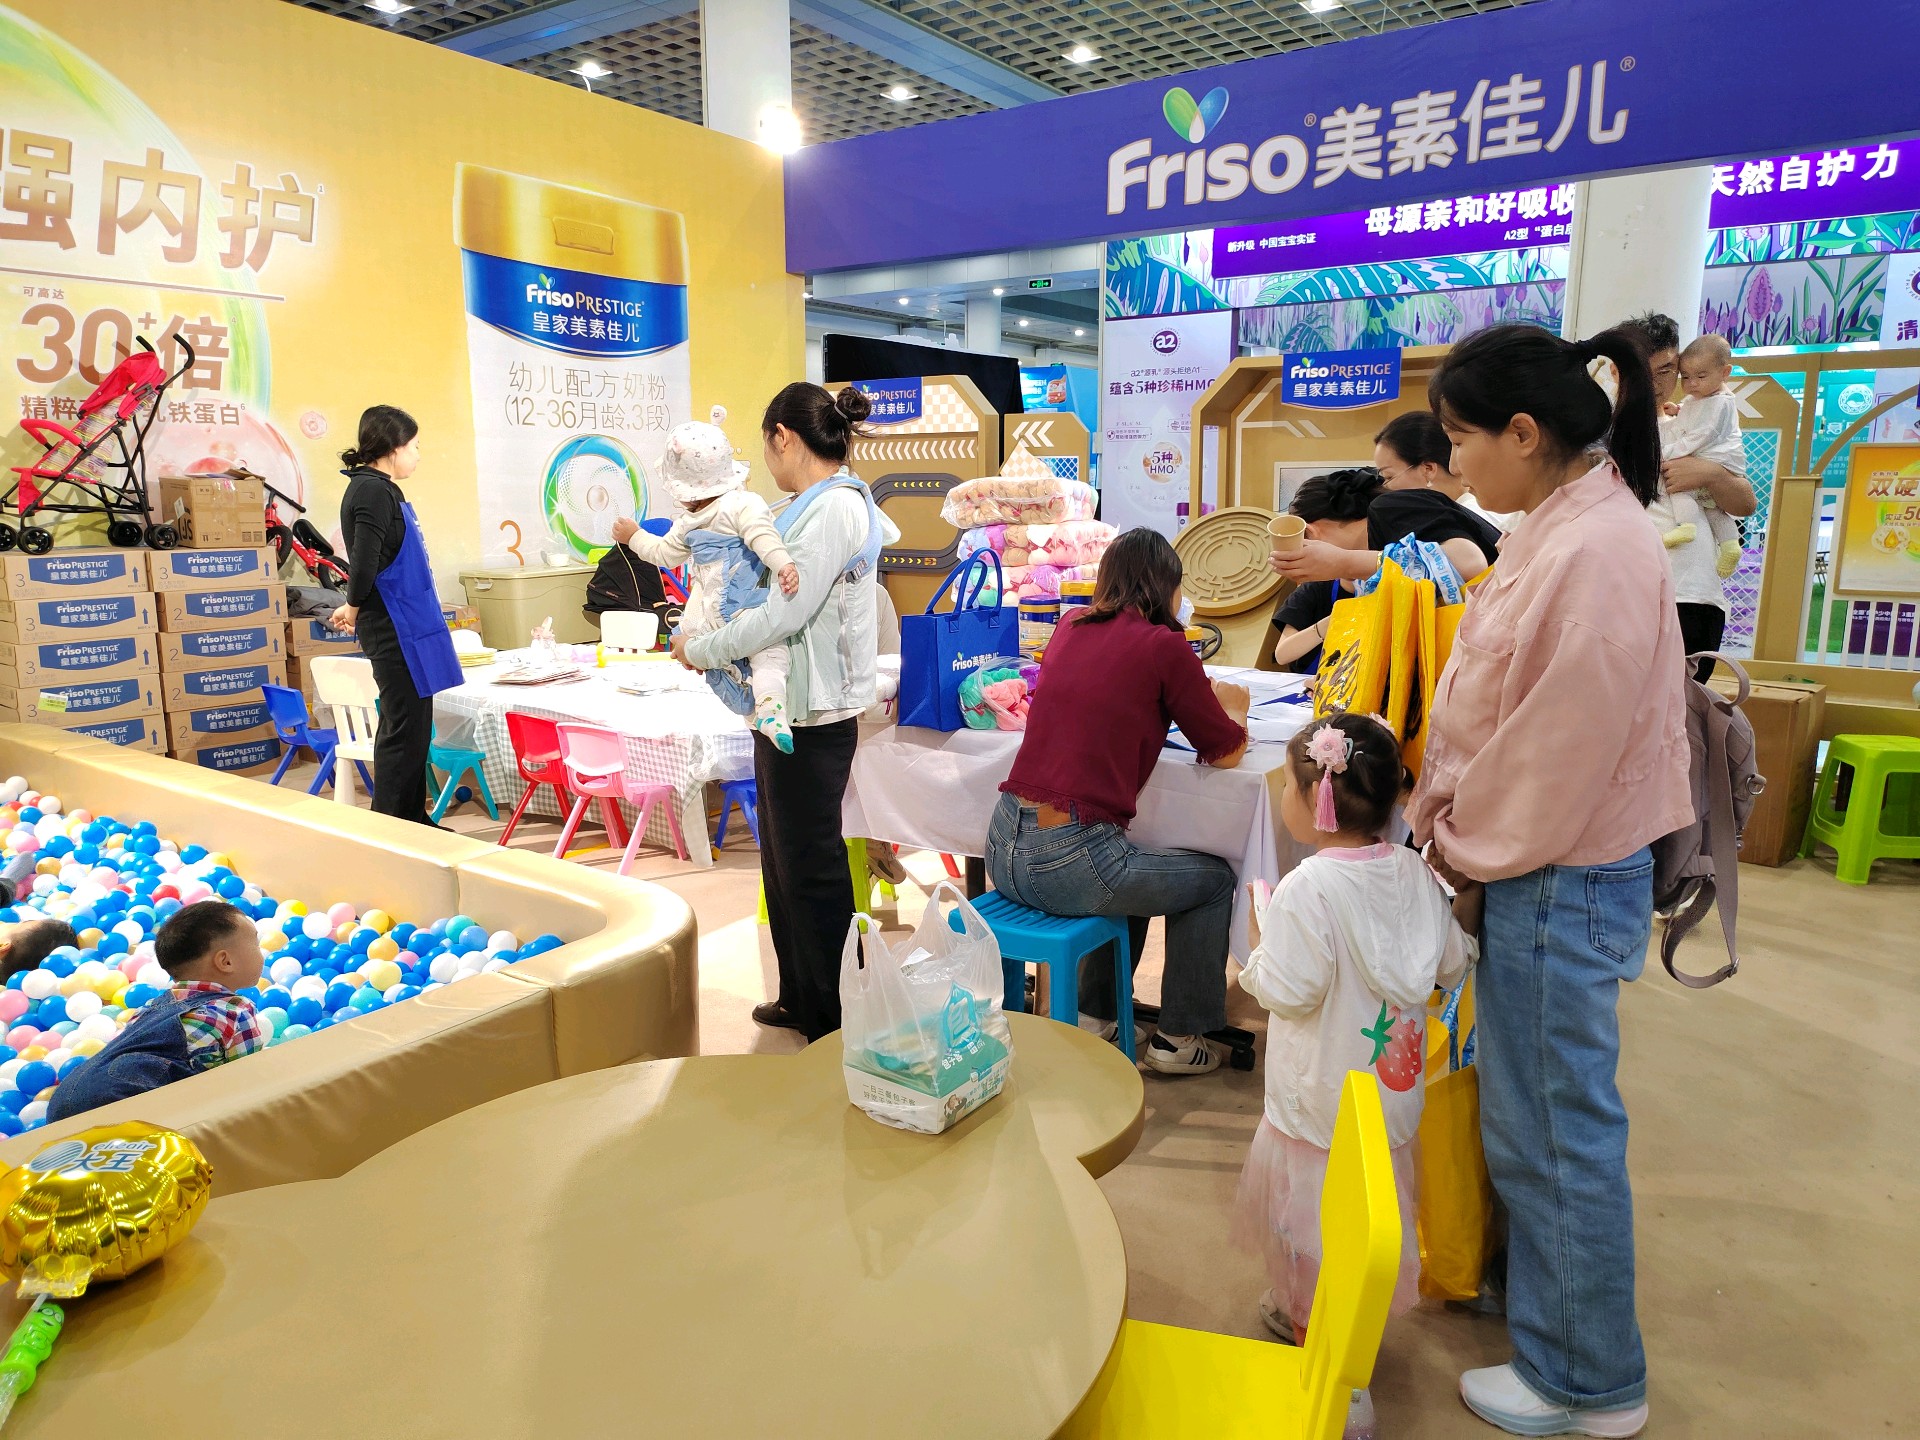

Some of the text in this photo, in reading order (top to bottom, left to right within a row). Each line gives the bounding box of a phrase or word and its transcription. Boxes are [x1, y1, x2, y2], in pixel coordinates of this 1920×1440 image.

[1107, 59, 1630, 216] Friso 美素佳儿
[1710, 144, 1899, 197] 天然自护力
[0, 128, 316, 272] 强内护
[1365, 184, 1576, 236] 母源亲和好吸收
[1504, 227, 1528, 241] A2型
[1227, 232, 1317, 253] 新升级 中国宝宝实证
[23, 286, 65, 300] 可高达
[526, 280, 643, 318] Friso PRESTIGE
[533, 310, 640, 343] 皇家美素佳儿
[1155, 334, 1176, 348] a2
[1291, 360, 1391, 380] Friso PRESTIGE
[508, 360, 667, 401] 幼儿配方奶粉
[880, 390, 916, 401] PRESTIGE
[1293, 379, 1387, 398] 皇家美素佳儿
[1152, 451, 1173, 465] 5种
[1868, 477, 1920, 497] 双硬
[47, 561, 108, 570] Friso PRESTIGE
[188, 555, 209, 564] Friso
[201, 596, 223, 605] Friso
[57, 603, 118, 613] Friso PRESTIGE
[198, 634, 252, 645] Friso PRESTIGE
[57, 645, 119, 656] Friso PRESTIGE
[952, 655, 972, 672] Friso
[200, 672, 254, 683] Friso PRESTIGE
[85, 686, 122, 696] PRESTIGE
[207, 708, 260, 721] Friso PRESTIGE
[91, 727, 128, 737] PRESTIGE
[213, 746, 267, 759] Friso PRESTIGE
[61, 1153, 141, 1175] 大王
